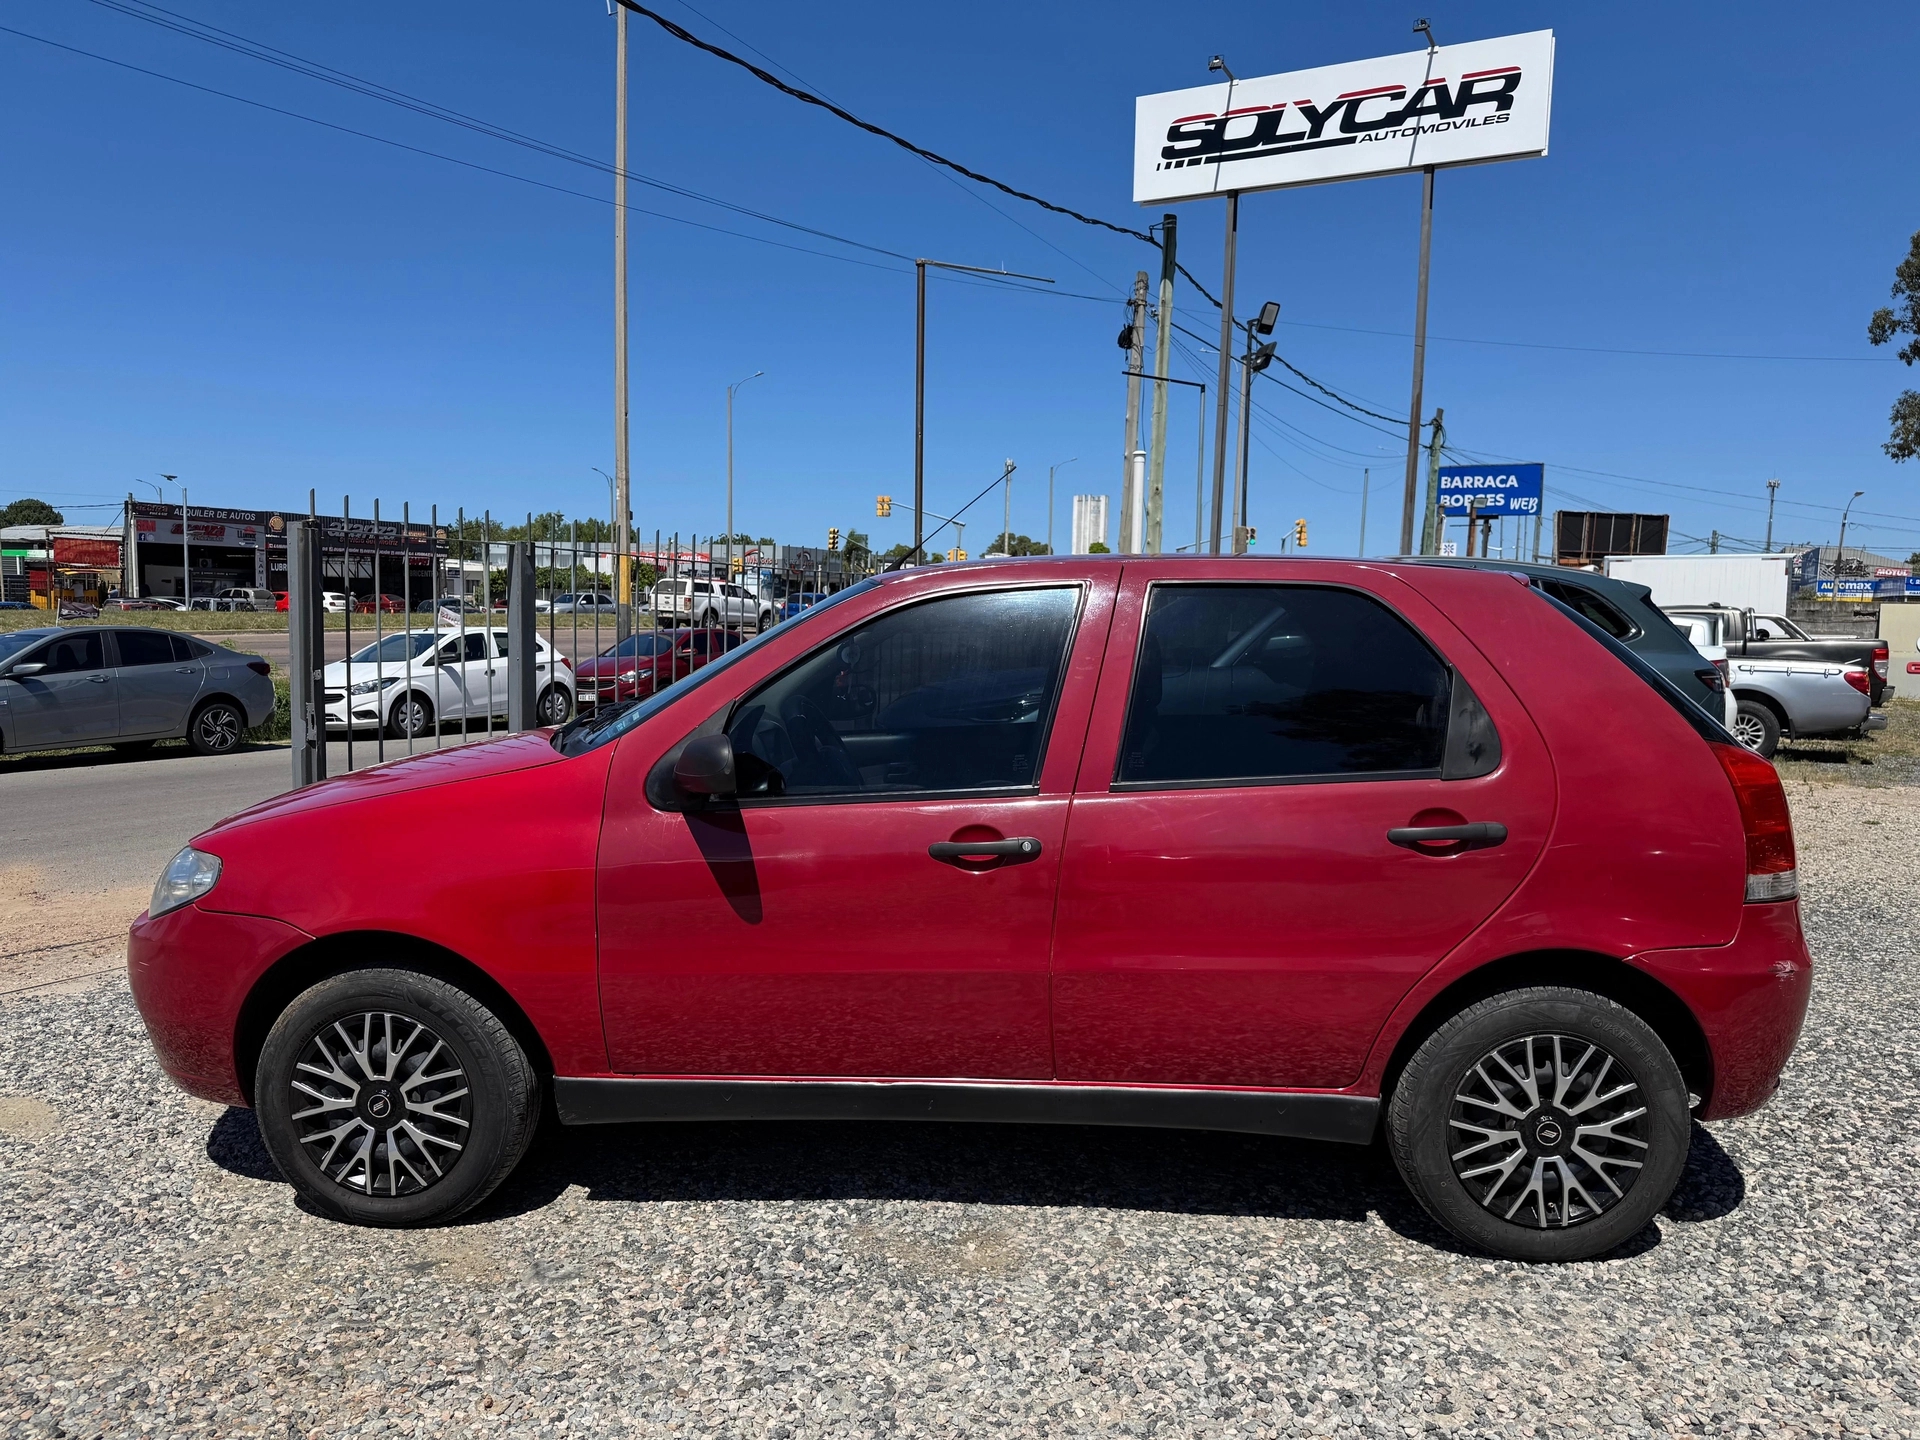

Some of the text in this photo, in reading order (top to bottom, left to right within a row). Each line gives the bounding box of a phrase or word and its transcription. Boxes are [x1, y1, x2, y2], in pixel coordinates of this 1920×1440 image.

[1161, 66, 1522, 159] SOLYCAR
[1357, 113, 1510, 144] AUTOMOVILES
[1440, 475, 1519, 489] BARRACA
[1510, 497, 1538, 513] WEB
[174, 507, 256, 521] ALQUILER DE AUTOS
[1876, 568, 1908, 577] MOTUL
